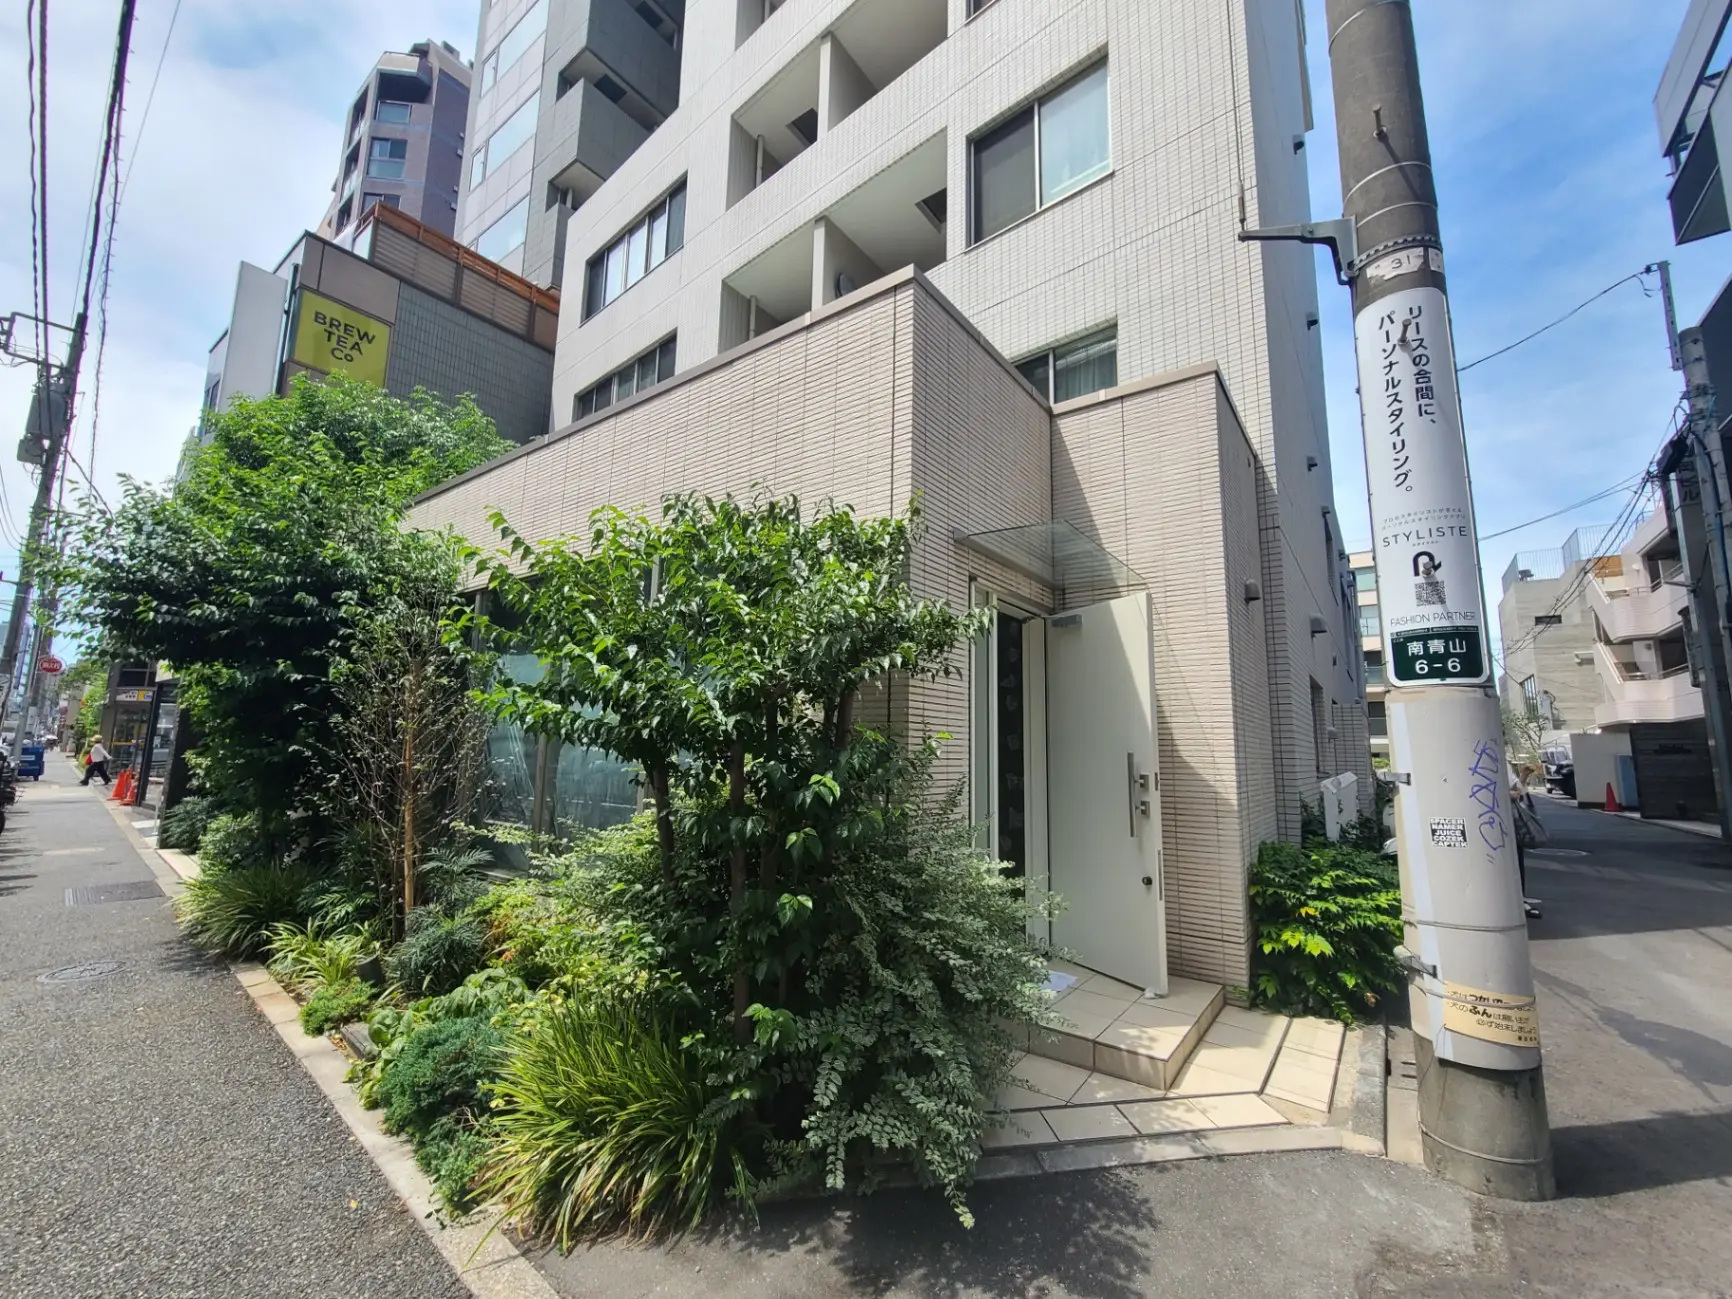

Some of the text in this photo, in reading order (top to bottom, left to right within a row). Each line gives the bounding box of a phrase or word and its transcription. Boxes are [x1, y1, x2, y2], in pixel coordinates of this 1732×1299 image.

[314, 311, 375, 344] BREW
[324, 329, 363, 355] TEA
[1409, 305, 1436, 424] リースの合間に、
[1378, 310, 1413, 492] パーソナルスタイリング。
[1382, 526, 1468, 547] STYLISTE
[1390, 611, 1476, 627] FASHION PARTNER
[1406, 638, 1466, 656] 南青山
[1415, 657, 1461, 674] 6-6
